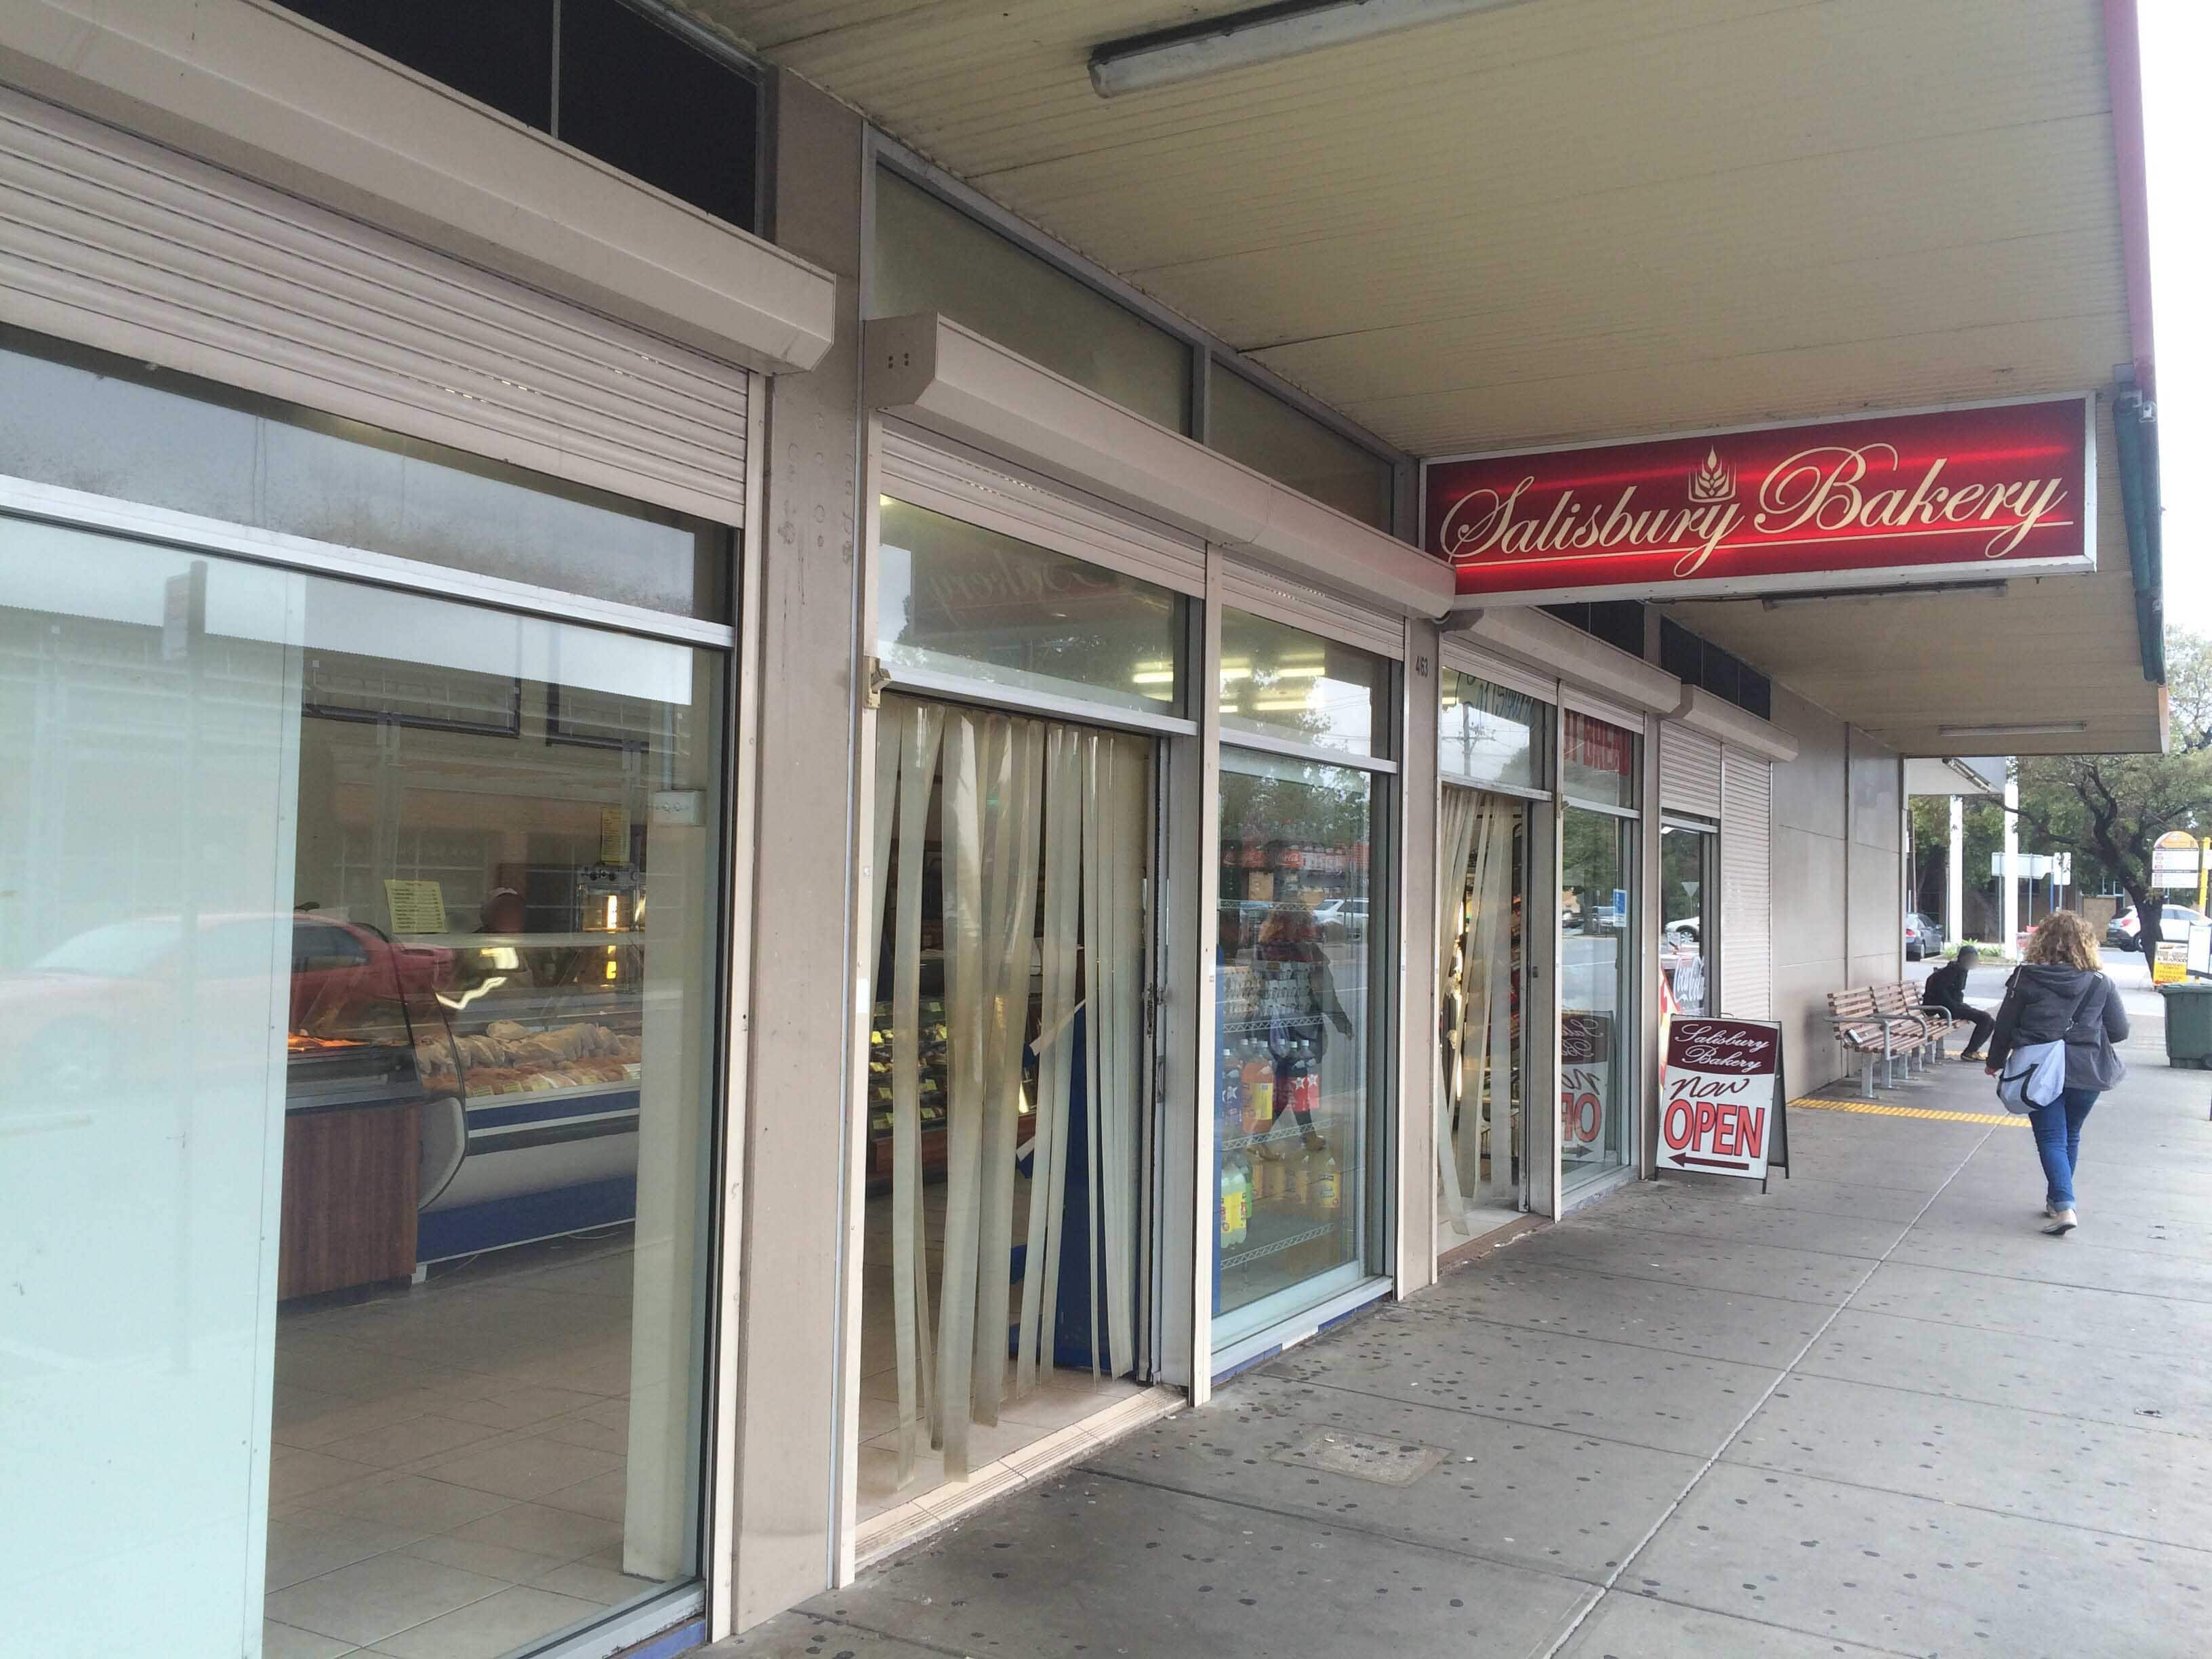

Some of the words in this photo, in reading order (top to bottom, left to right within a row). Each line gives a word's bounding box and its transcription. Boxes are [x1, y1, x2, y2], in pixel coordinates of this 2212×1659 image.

[1439, 476, 1744, 577] Salisbury
[1755, 443, 2068, 558] Bakery
[1675, 1023, 1771, 1052] Salisbury
[1681, 1044, 1762, 1073] Bakery
[1664, 1098, 1765, 1159] OPEN
